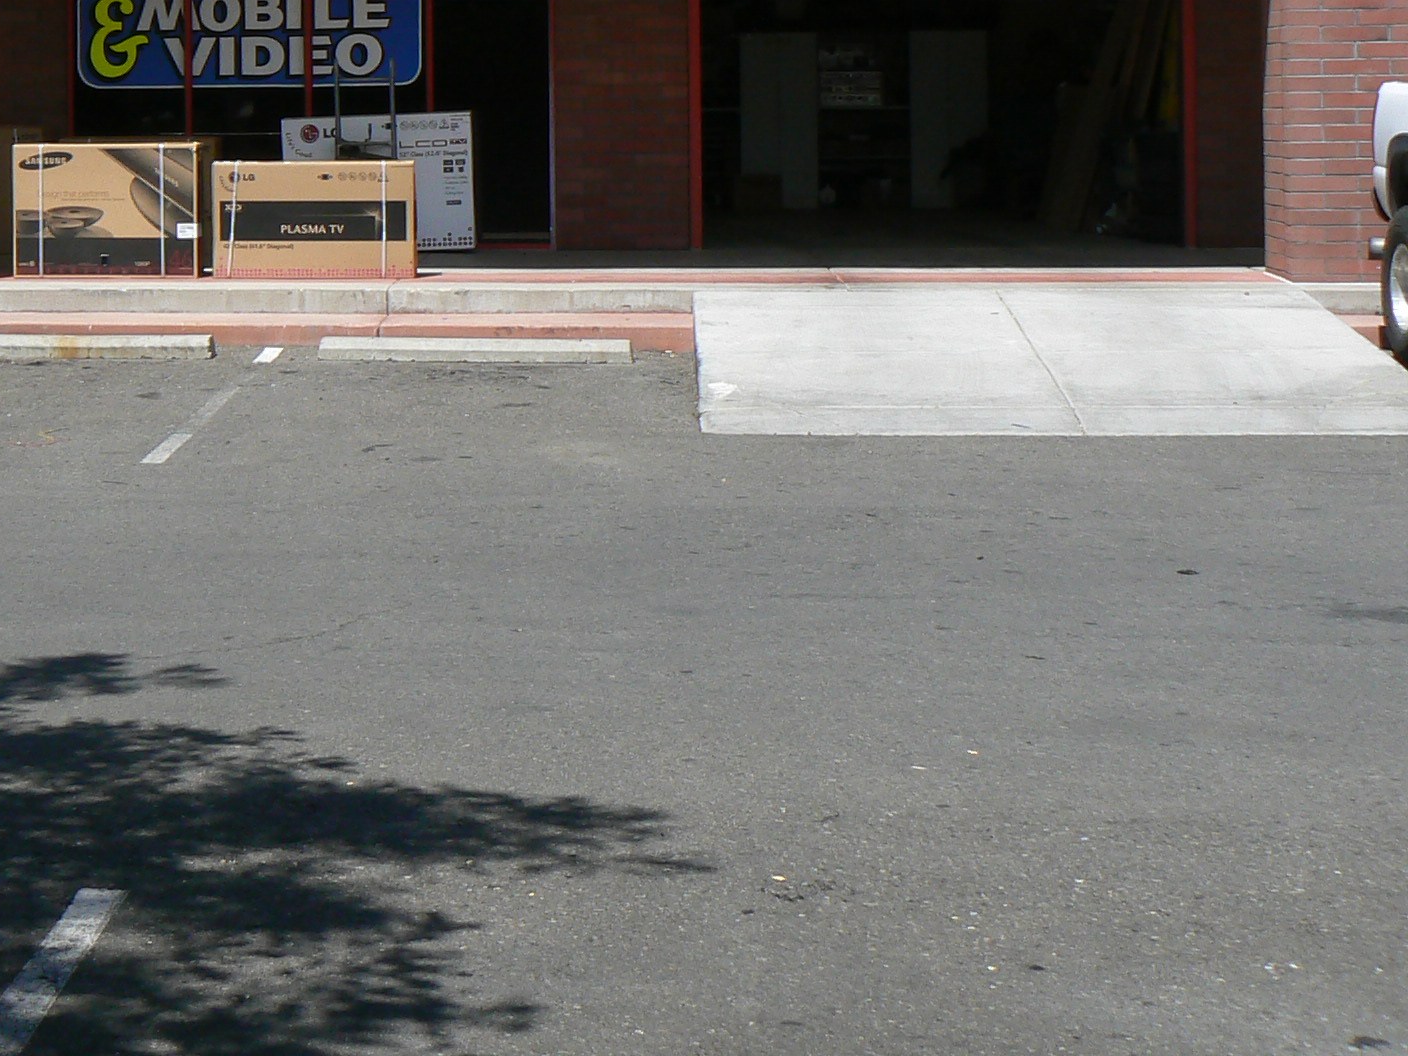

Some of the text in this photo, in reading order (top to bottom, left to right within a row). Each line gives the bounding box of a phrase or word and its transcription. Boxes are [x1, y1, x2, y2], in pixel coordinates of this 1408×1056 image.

[163, 32, 384, 78] VIDEO
[242, 173, 256, 182] LG
[280, 223, 345, 235] PLASMA TV
